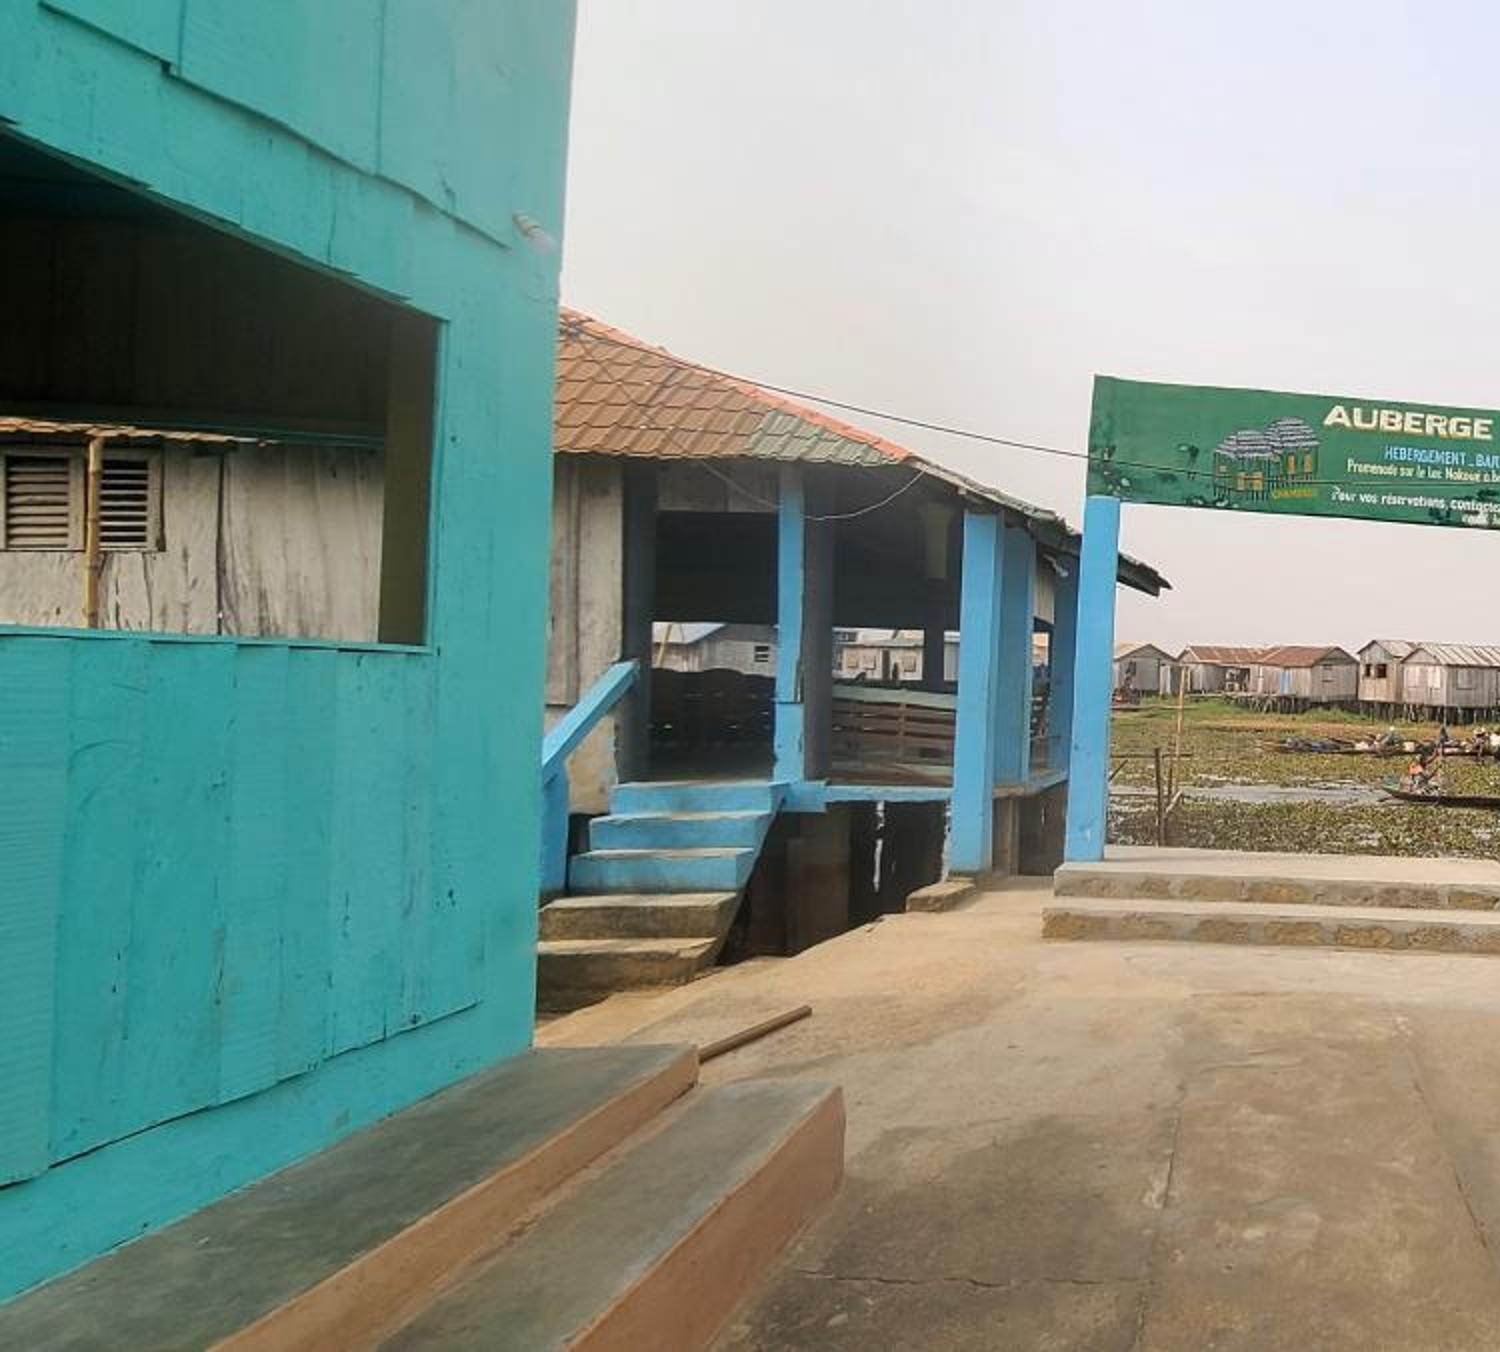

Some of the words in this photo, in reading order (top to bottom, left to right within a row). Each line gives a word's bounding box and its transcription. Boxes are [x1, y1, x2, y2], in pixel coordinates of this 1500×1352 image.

[1323, 405, 1493, 440] AUBERGE
[1384, 446, 1466, 466] HEBERGEMENT
[1331, 485, 1356, 502] Pour
[1360, 493, 1378, 504] vos
